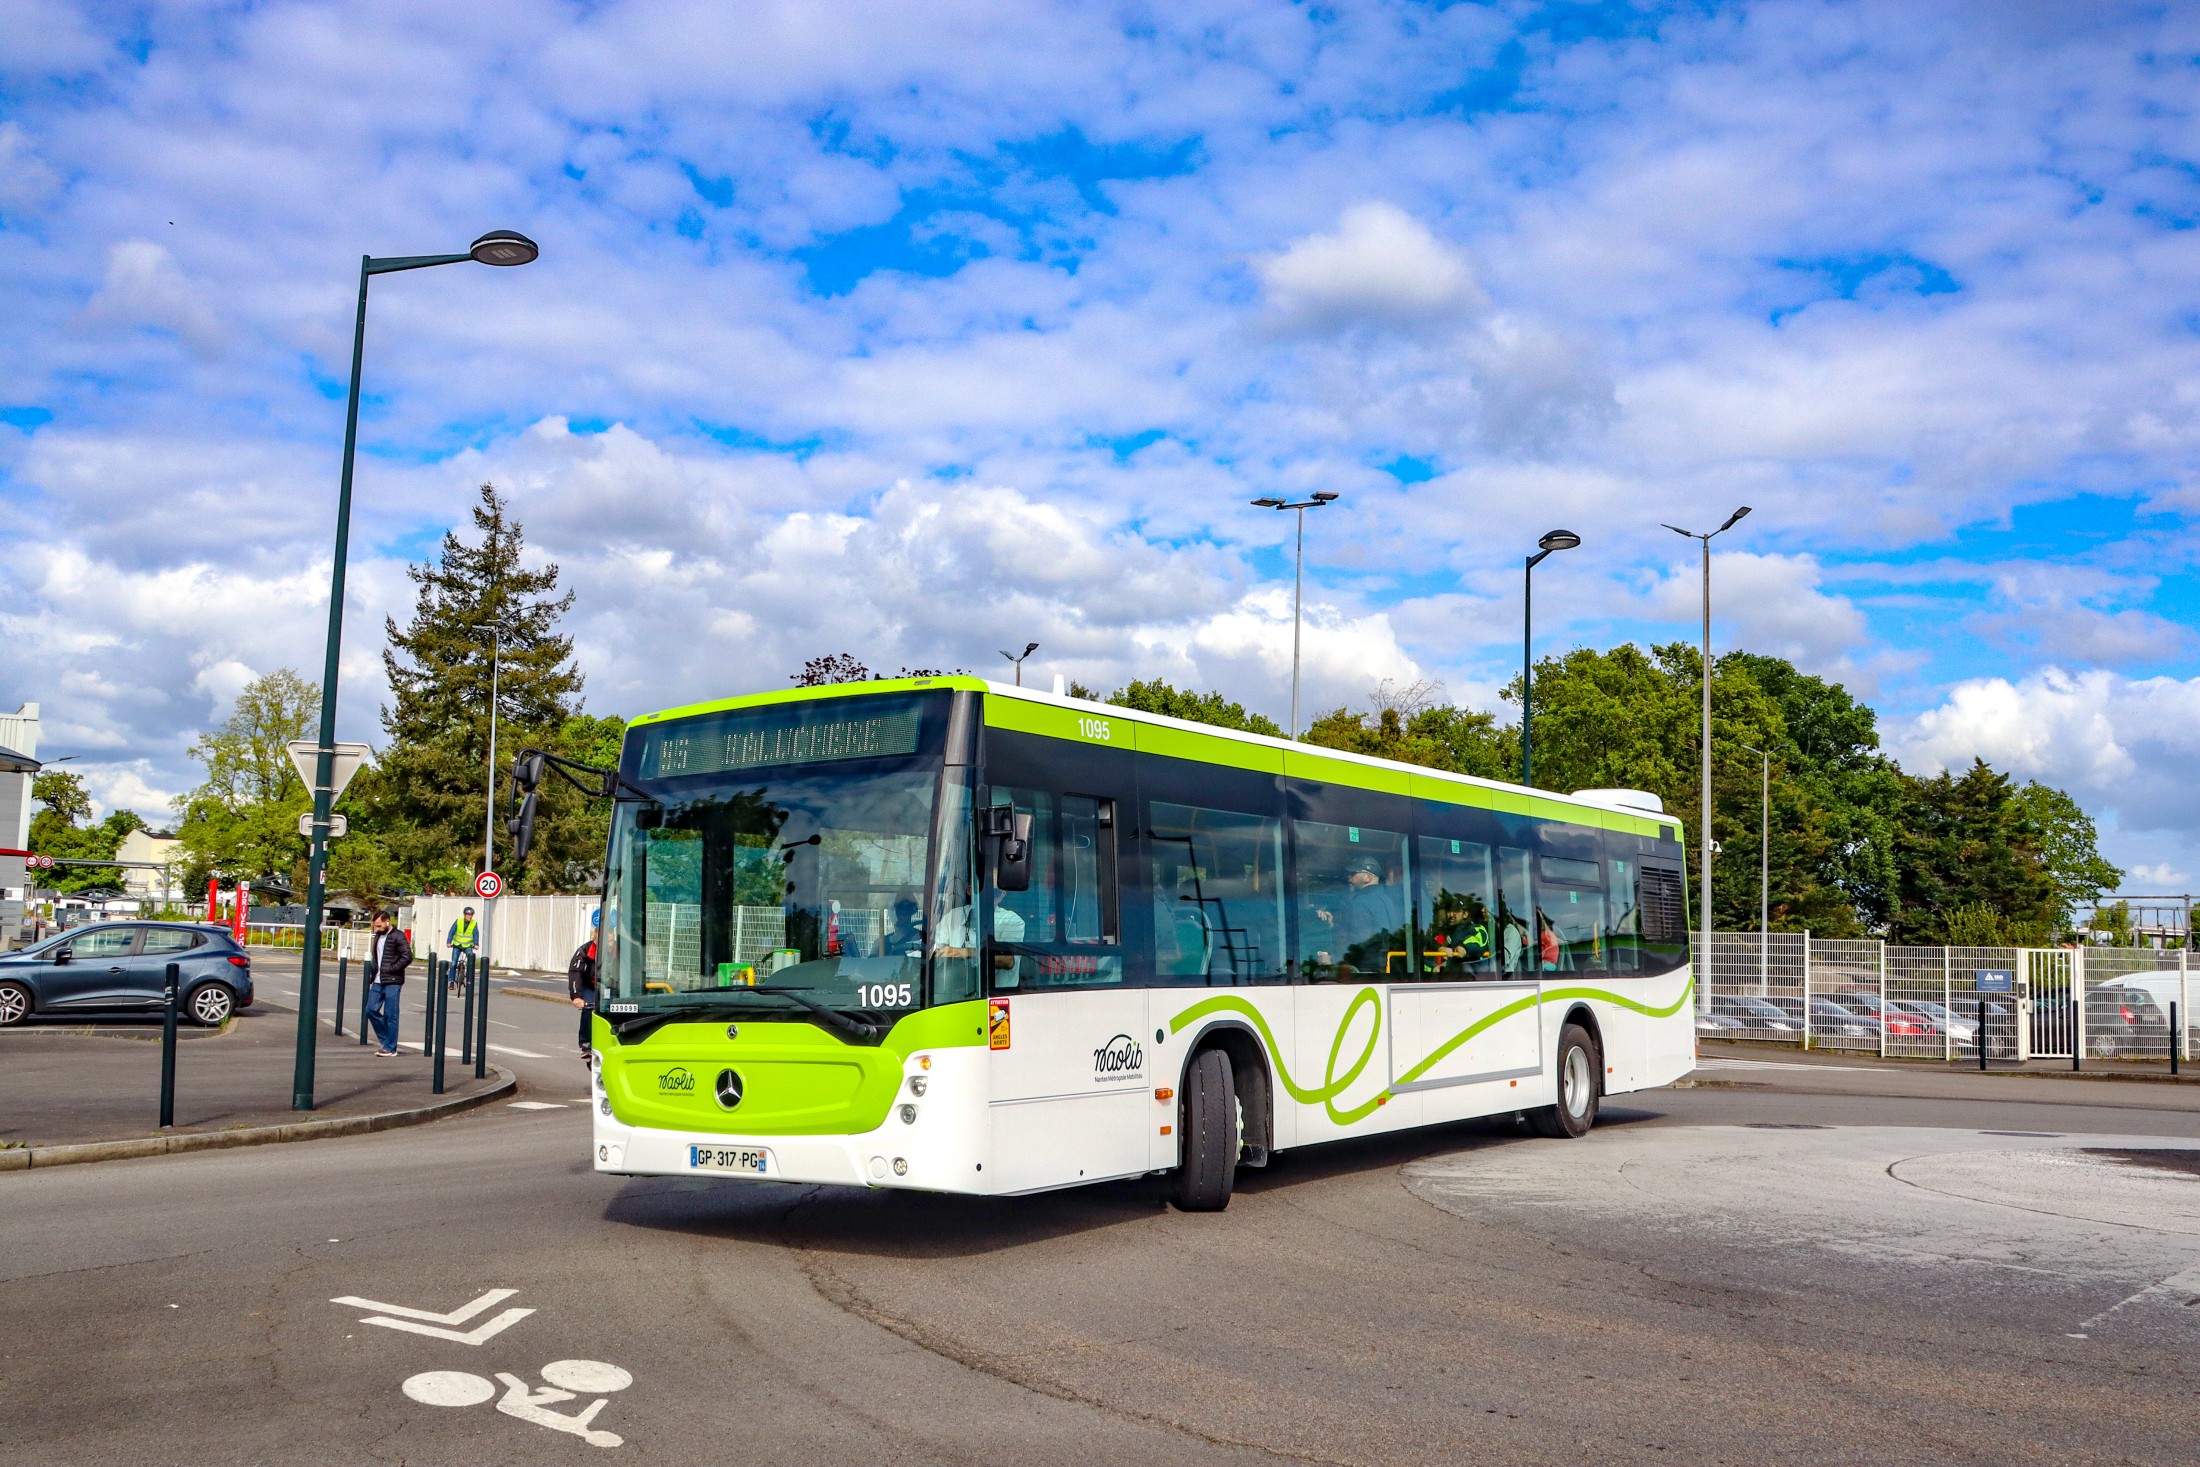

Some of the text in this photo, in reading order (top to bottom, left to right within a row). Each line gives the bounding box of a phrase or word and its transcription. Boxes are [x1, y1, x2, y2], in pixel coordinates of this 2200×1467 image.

[1078, 717, 1110, 741] 1095
[481, 880, 496, 890] 20
[240, 891, 248, 928] DRIVE
[857, 984, 911, 1007] 1095
[698, 1149, 758, 1168] GP-317-PG
